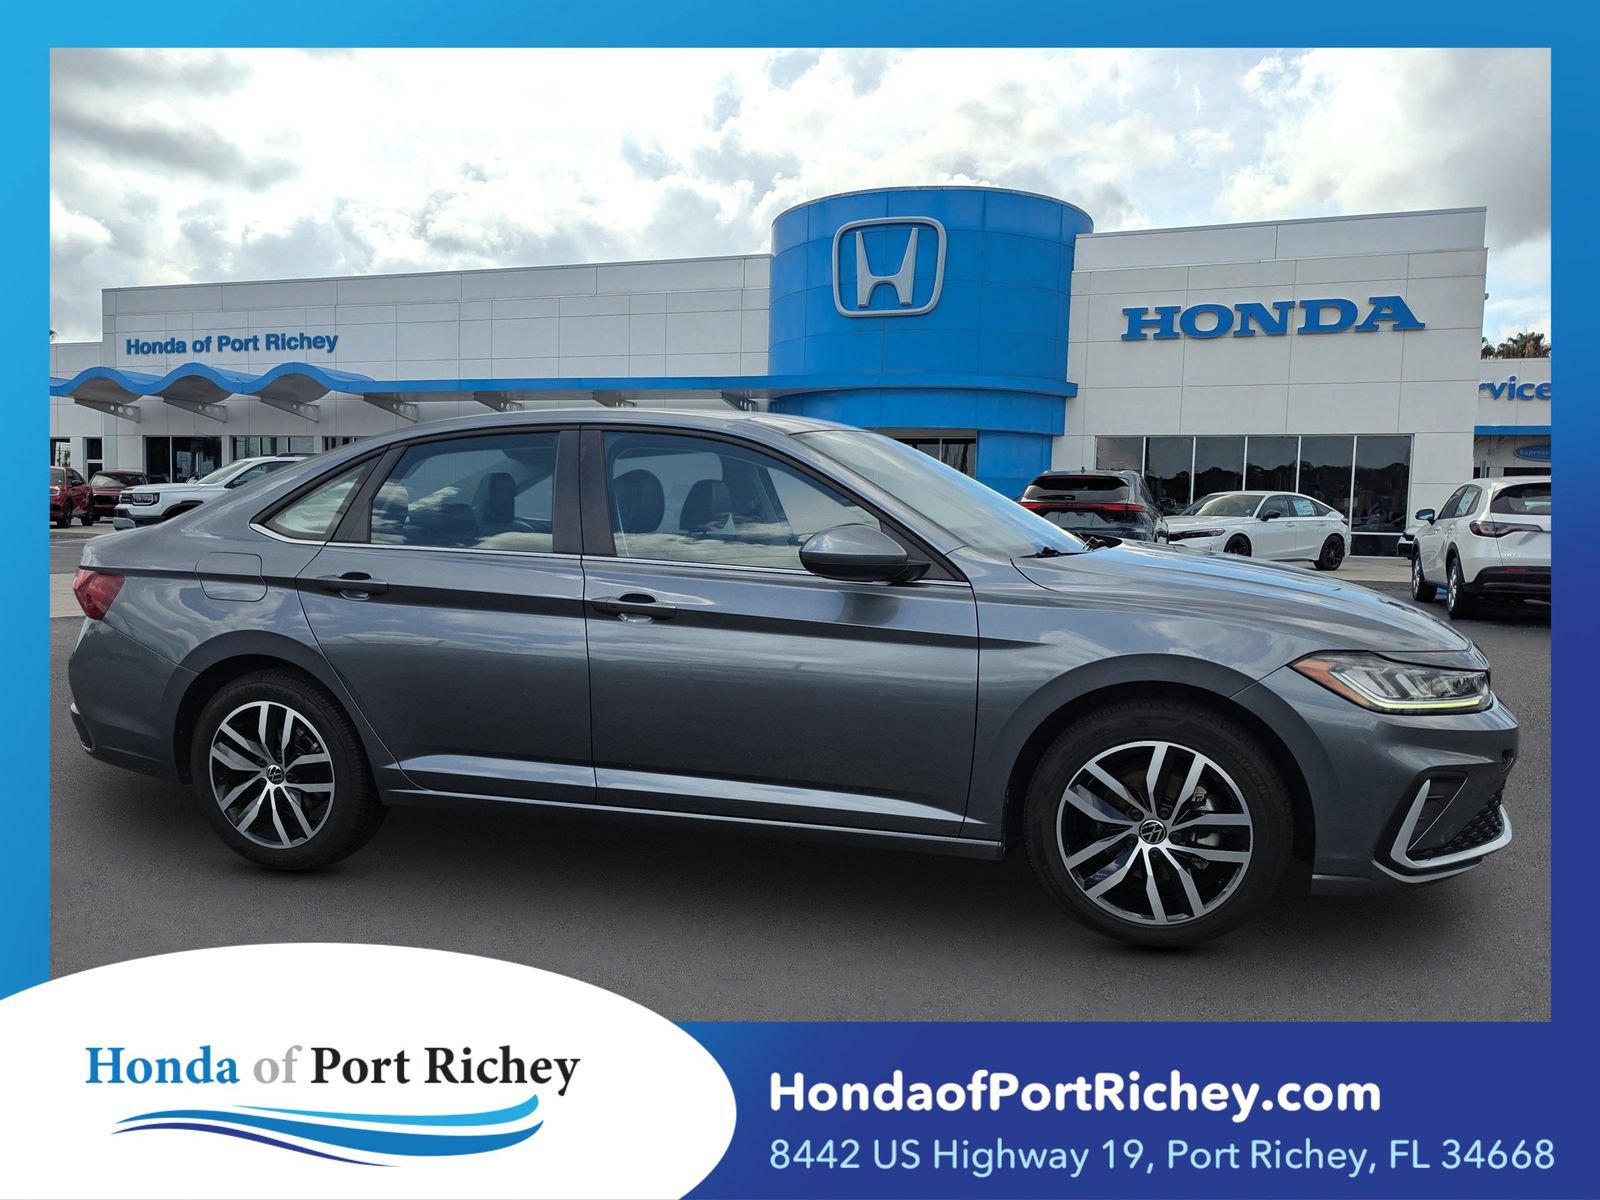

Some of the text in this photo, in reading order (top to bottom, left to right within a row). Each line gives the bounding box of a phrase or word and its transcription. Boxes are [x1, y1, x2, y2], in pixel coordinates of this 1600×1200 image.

[1121, 295, 1425, 341] HONDA
[126, 332, 338, 355] Honda of Port Richey
